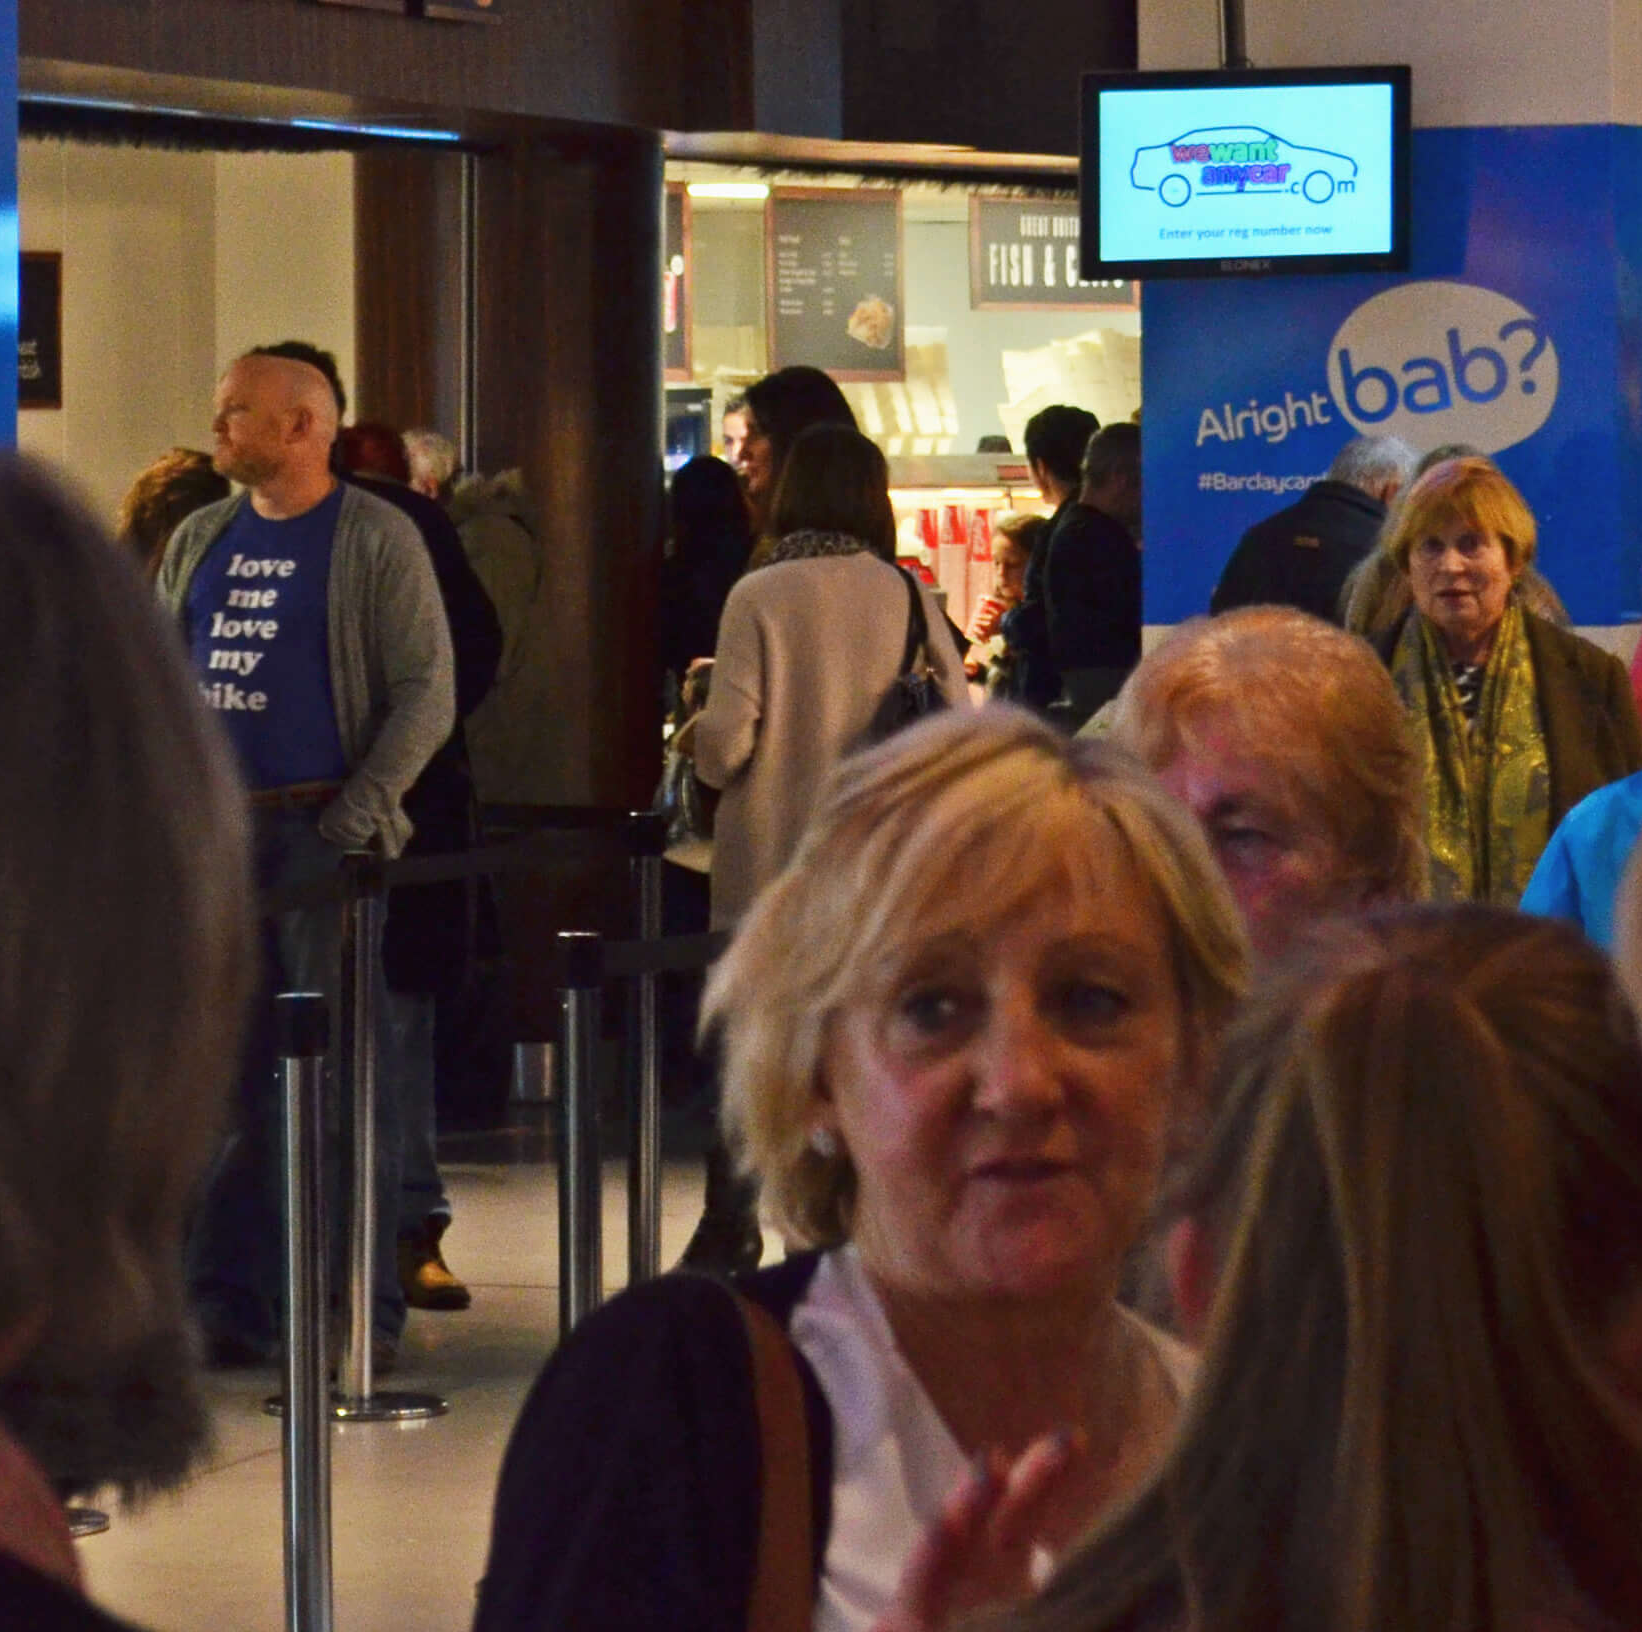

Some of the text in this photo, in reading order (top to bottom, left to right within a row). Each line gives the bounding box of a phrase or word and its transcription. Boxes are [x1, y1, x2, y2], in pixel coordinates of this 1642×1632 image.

[1158, 223, 1334, 241] Enter your reg number now
[989, 244, 1033, 287] FISH
[1195, 391, 1332, 447] Alright
[1337, 318, 1552, 425] bab?
[226, 554, 296, 578] love
[227, 588, 279, 609] me
[210, 612, 279, 640] love
[208, 649, 264, 676] my
[199, 682, 268, 711] ike
